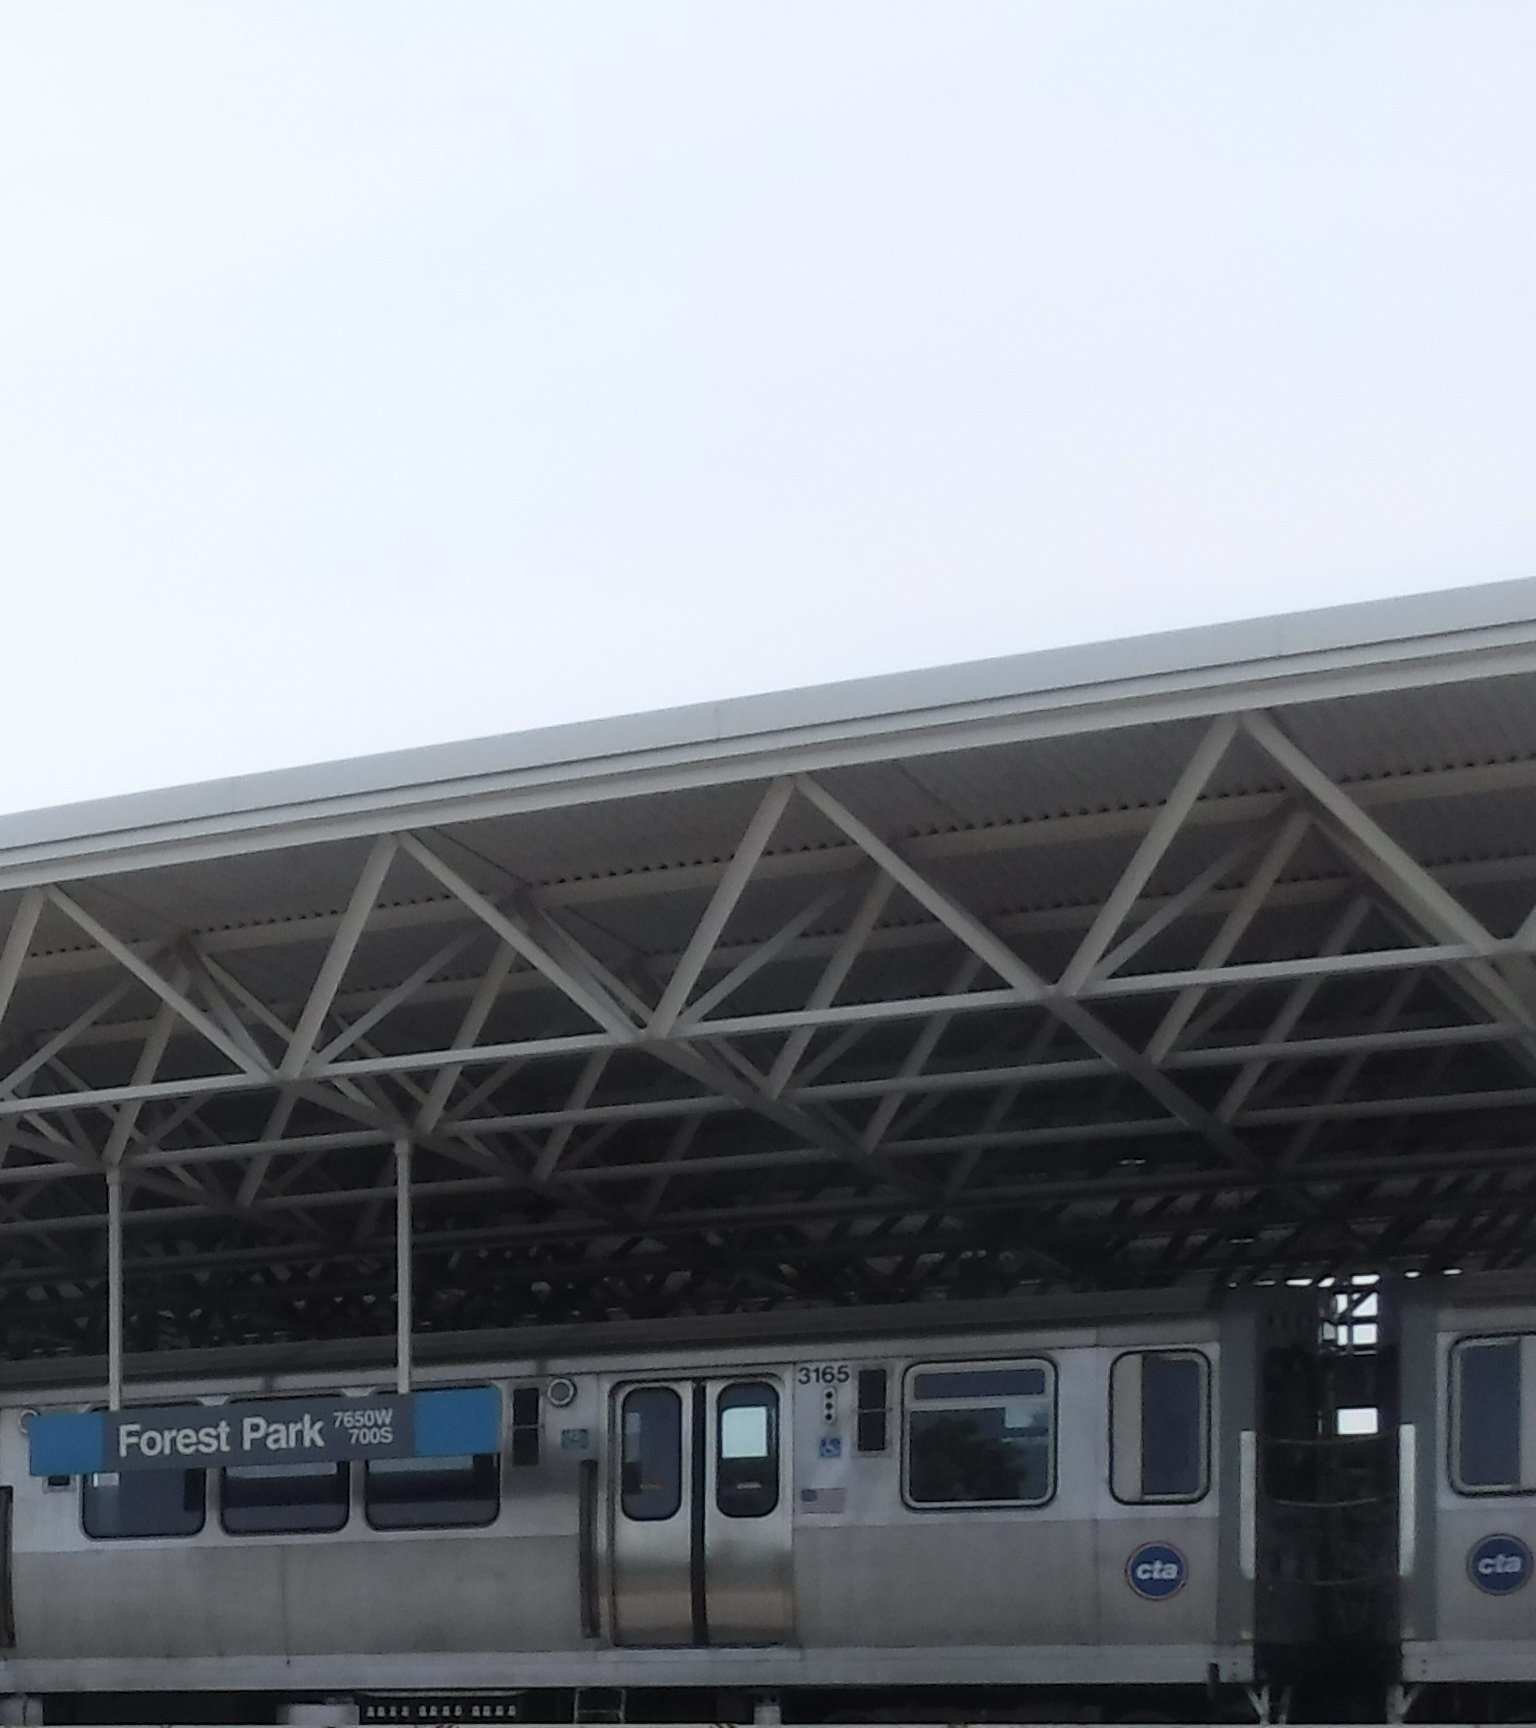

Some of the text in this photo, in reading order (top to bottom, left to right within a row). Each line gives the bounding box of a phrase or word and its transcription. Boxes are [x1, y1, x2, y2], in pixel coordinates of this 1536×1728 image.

[798, 1364, 850, 1384] 3165
[333, 1408, 394, 1428] 7650W
[118, 1413, 326, 1457] Forest Park
[348, 1428, 394, 1445] 700S
[1137, 1560, 1178, 1580] cta
[1479, 1554, 1521, 1574] cta
